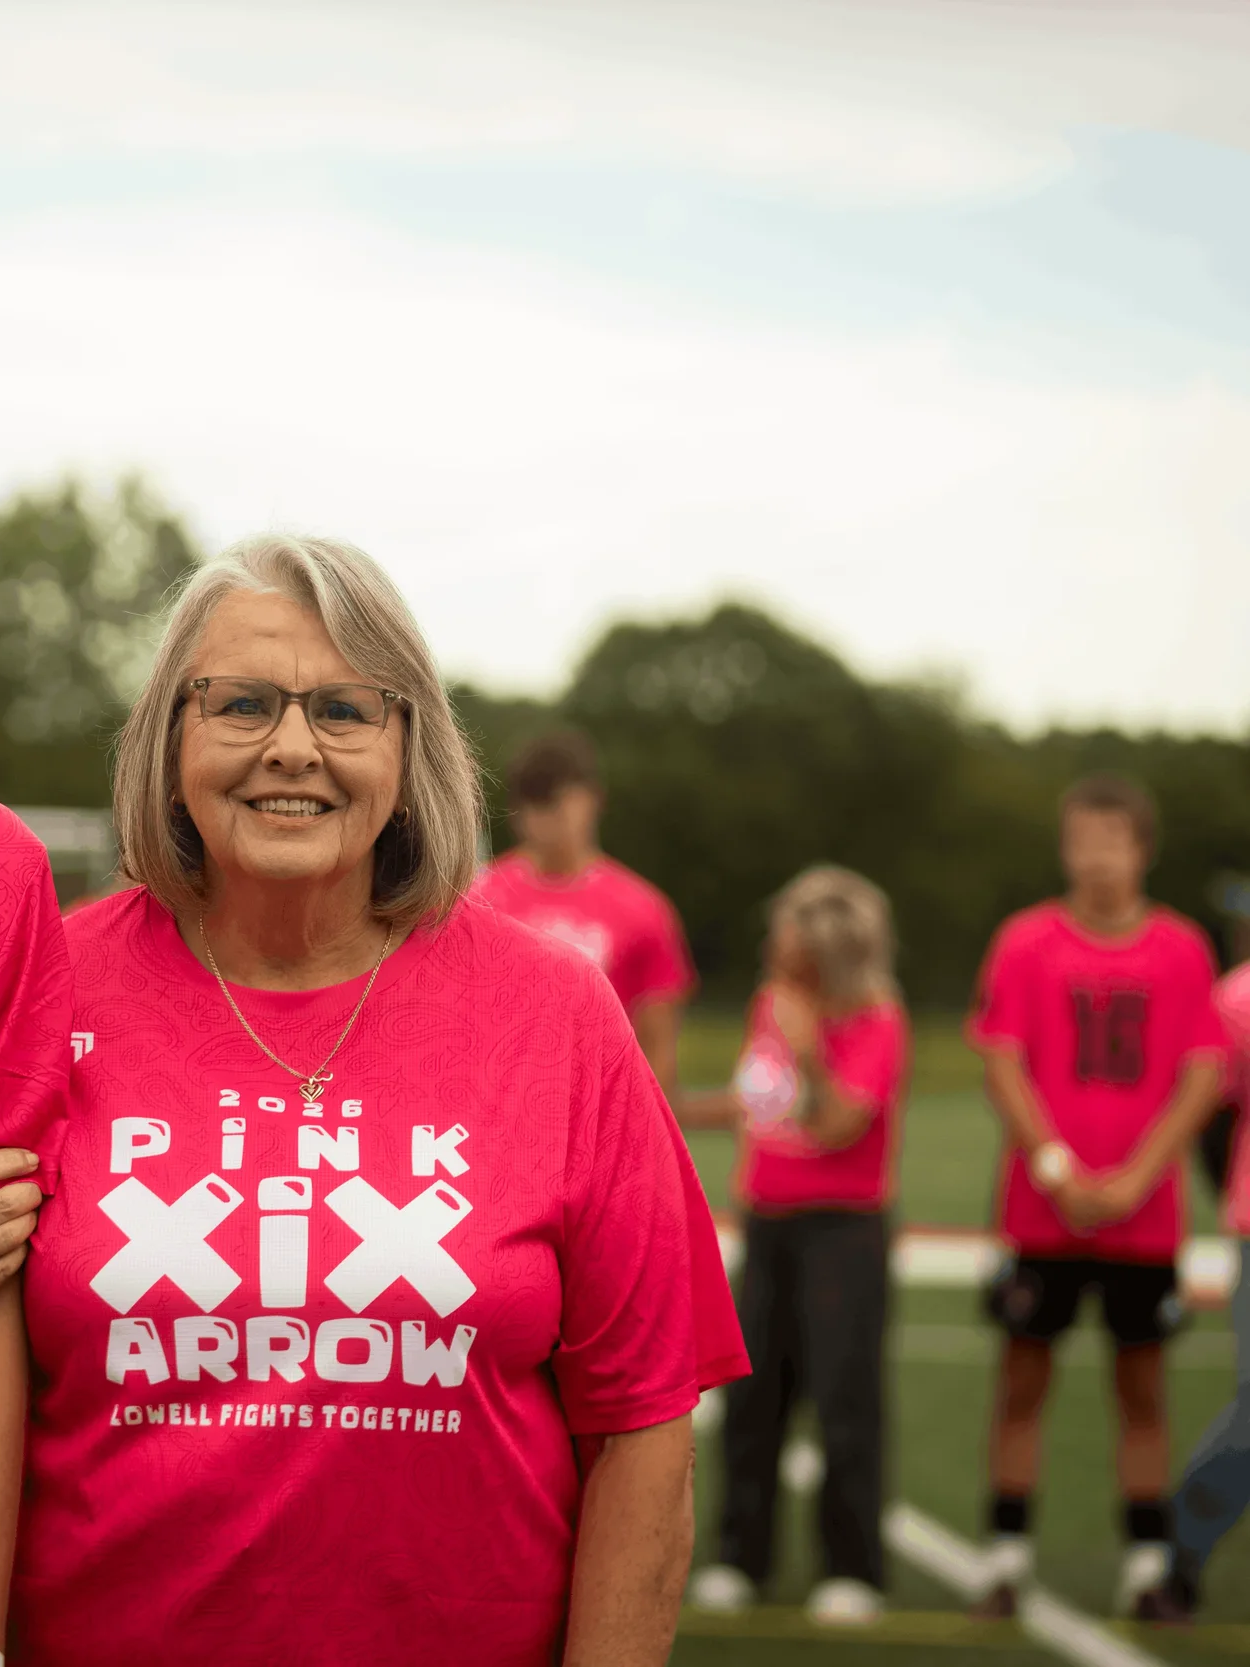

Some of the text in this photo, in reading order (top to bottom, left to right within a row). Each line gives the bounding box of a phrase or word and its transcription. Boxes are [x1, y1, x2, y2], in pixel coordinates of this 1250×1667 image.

[219, 1089, 362, 1118] 2026
[105, 1315, 478, 1388] ARROW
[110, 1403, 213, 1427] LOWELL
[321, 1404, 461, 1434] TOGETHER
